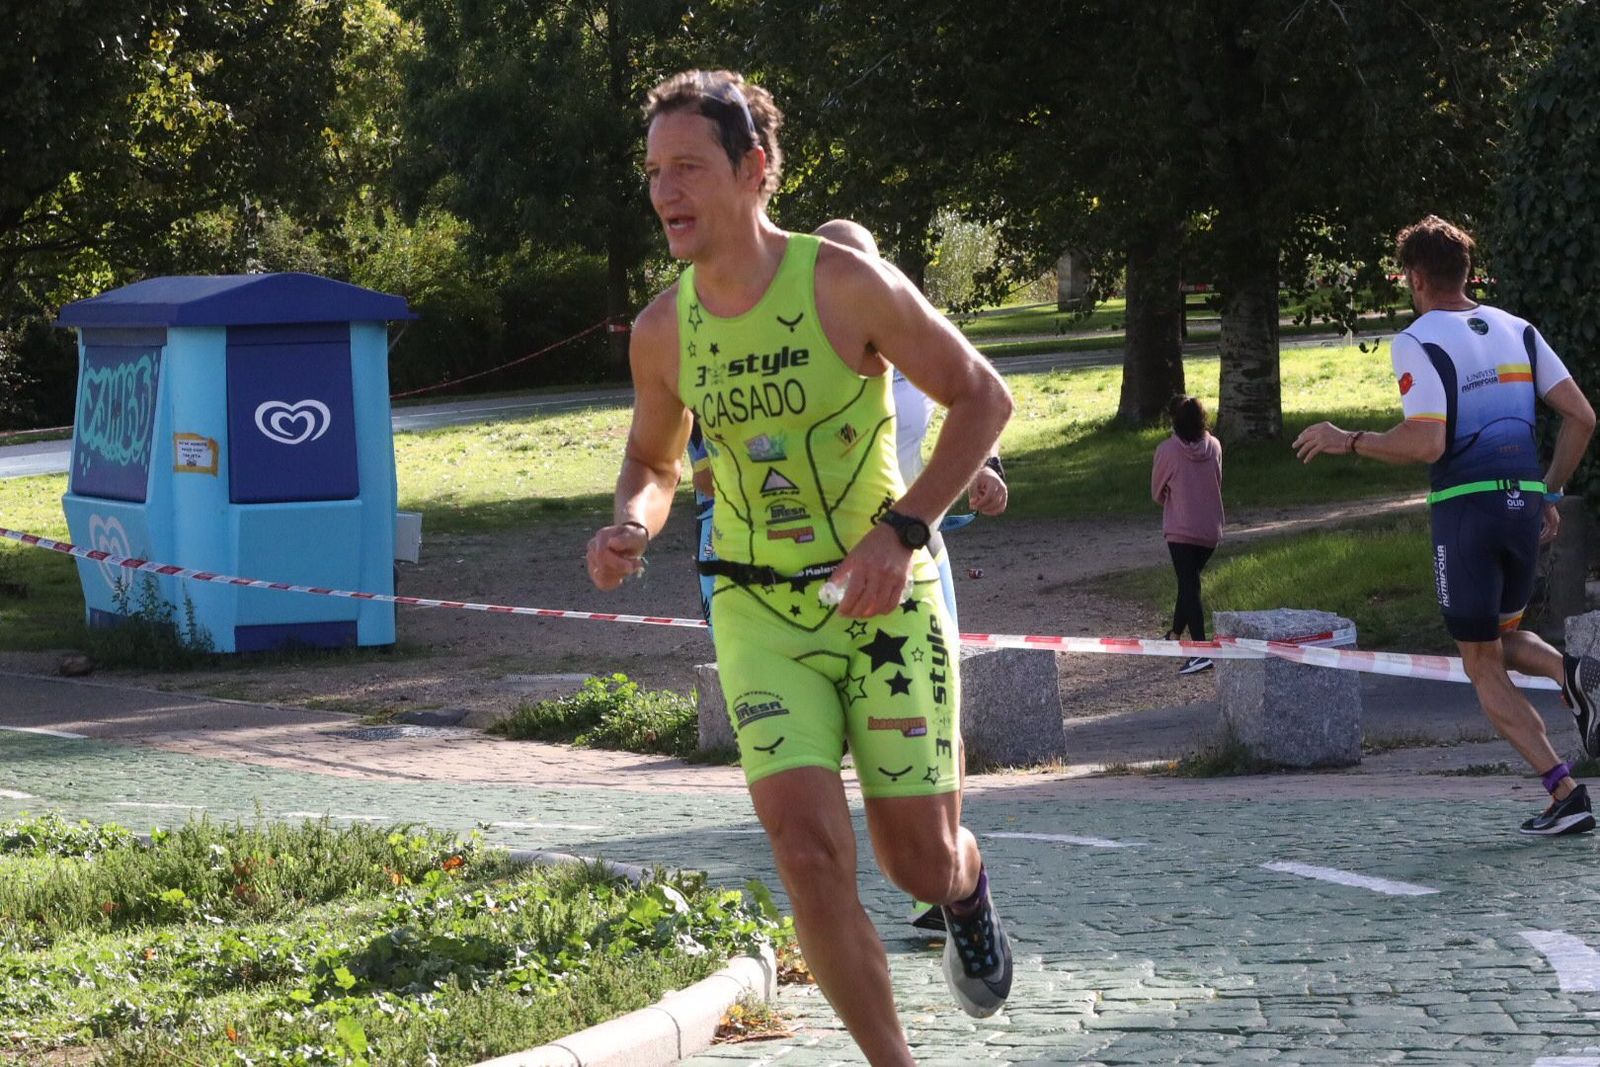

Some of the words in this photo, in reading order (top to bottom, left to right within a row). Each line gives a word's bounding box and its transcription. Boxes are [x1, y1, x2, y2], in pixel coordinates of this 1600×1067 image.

[728, 346, 809, 377] style
[702, 378, 806, 428] CASADO
[927, 614, 949, 705] style
